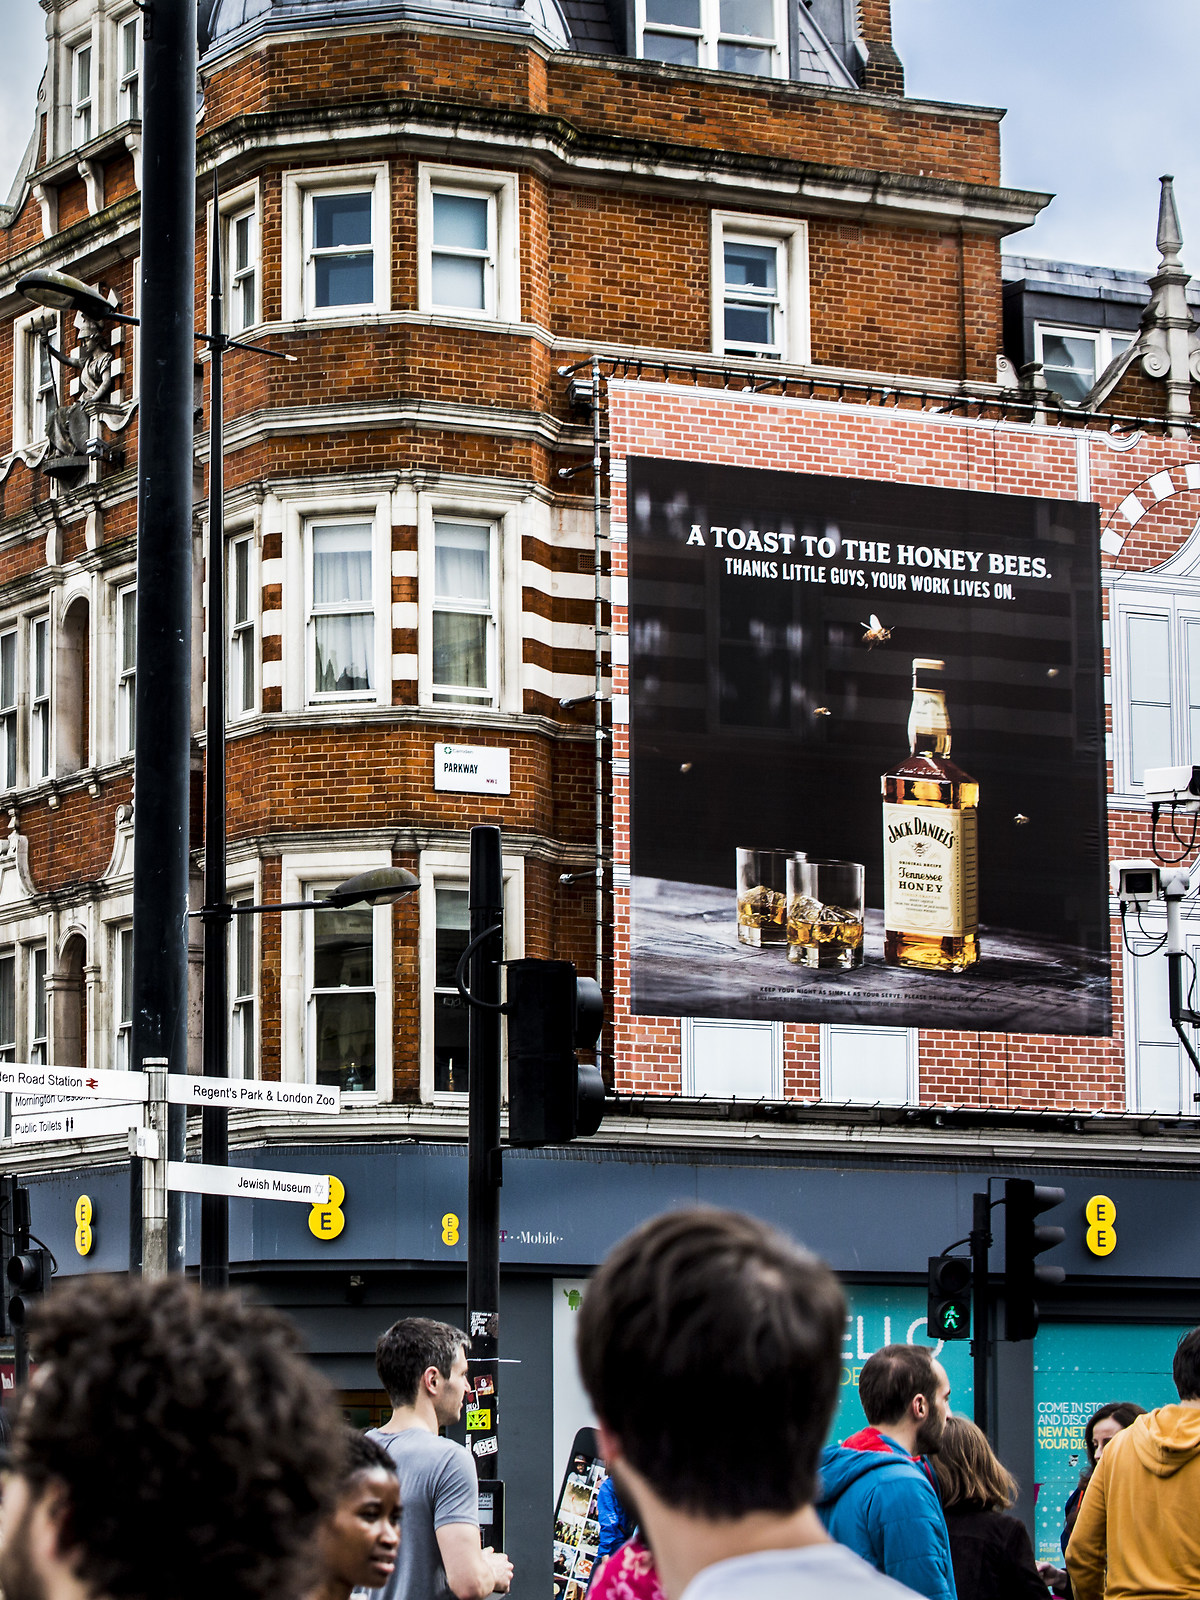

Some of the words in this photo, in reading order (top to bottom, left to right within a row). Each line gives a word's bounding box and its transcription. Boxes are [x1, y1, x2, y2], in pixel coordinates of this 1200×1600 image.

[686, 525, 706, 547] A
[710, 526, 796, 555] TOAST
[801, 535, 837, 559] TO
[841, 539, 891, 564] THE
[897, 544, 984, 573] HONEY
[988, 553, 1052, 579] BEES.
[725, 557, 779, 580] THANKS
[782, 563, 827, 584] LITTLE
[830, 567, 869, 590] GUYS,
[871, 571, 907, 591] YOUR
[910, 575, 951, 595] WORK
[953, 579, 991, 599] LIVES
[994, 583, 1017, 601] ON.
[443, 762, 479, 775] PARKWAY
[887, 820, 912, 844] JACK
[914, 816, 957, 849] DANIEL'S
[898, 866, 943, 882] Tennessee
[898, 880, 943, 893] HONEY
[18, 1072, 45, 1085] Road
[48, 1074, 83, 1088] Station
[14, 1094, 56, 1108] Mornington
[193, 1084, 238, 1100] Regent's
[240, 1088, 263, 1101] Park
[266, 1090, 274, 1102] &
[276, 1091, 313, 1105] London
[316, 1094, 335, 1106] Zoo
[14, 1123, 38, 1135] Public
[38, 1120, 62, 1132] Toilets
[238, 1177, 270, 1191] Jewish
[273, 1179, 312, 1194] Museum
[1037, 1402, 1069, 1413] COME
[1071, 1402, 1083, 1413] IN
[1037, 1414, 1061, 1425] AND
[1038, 1426, 1063, 1438] NEW
[1064, 1426, 1087, 1438] NET
[1038, 1438, 1069, 1449] YOUR
